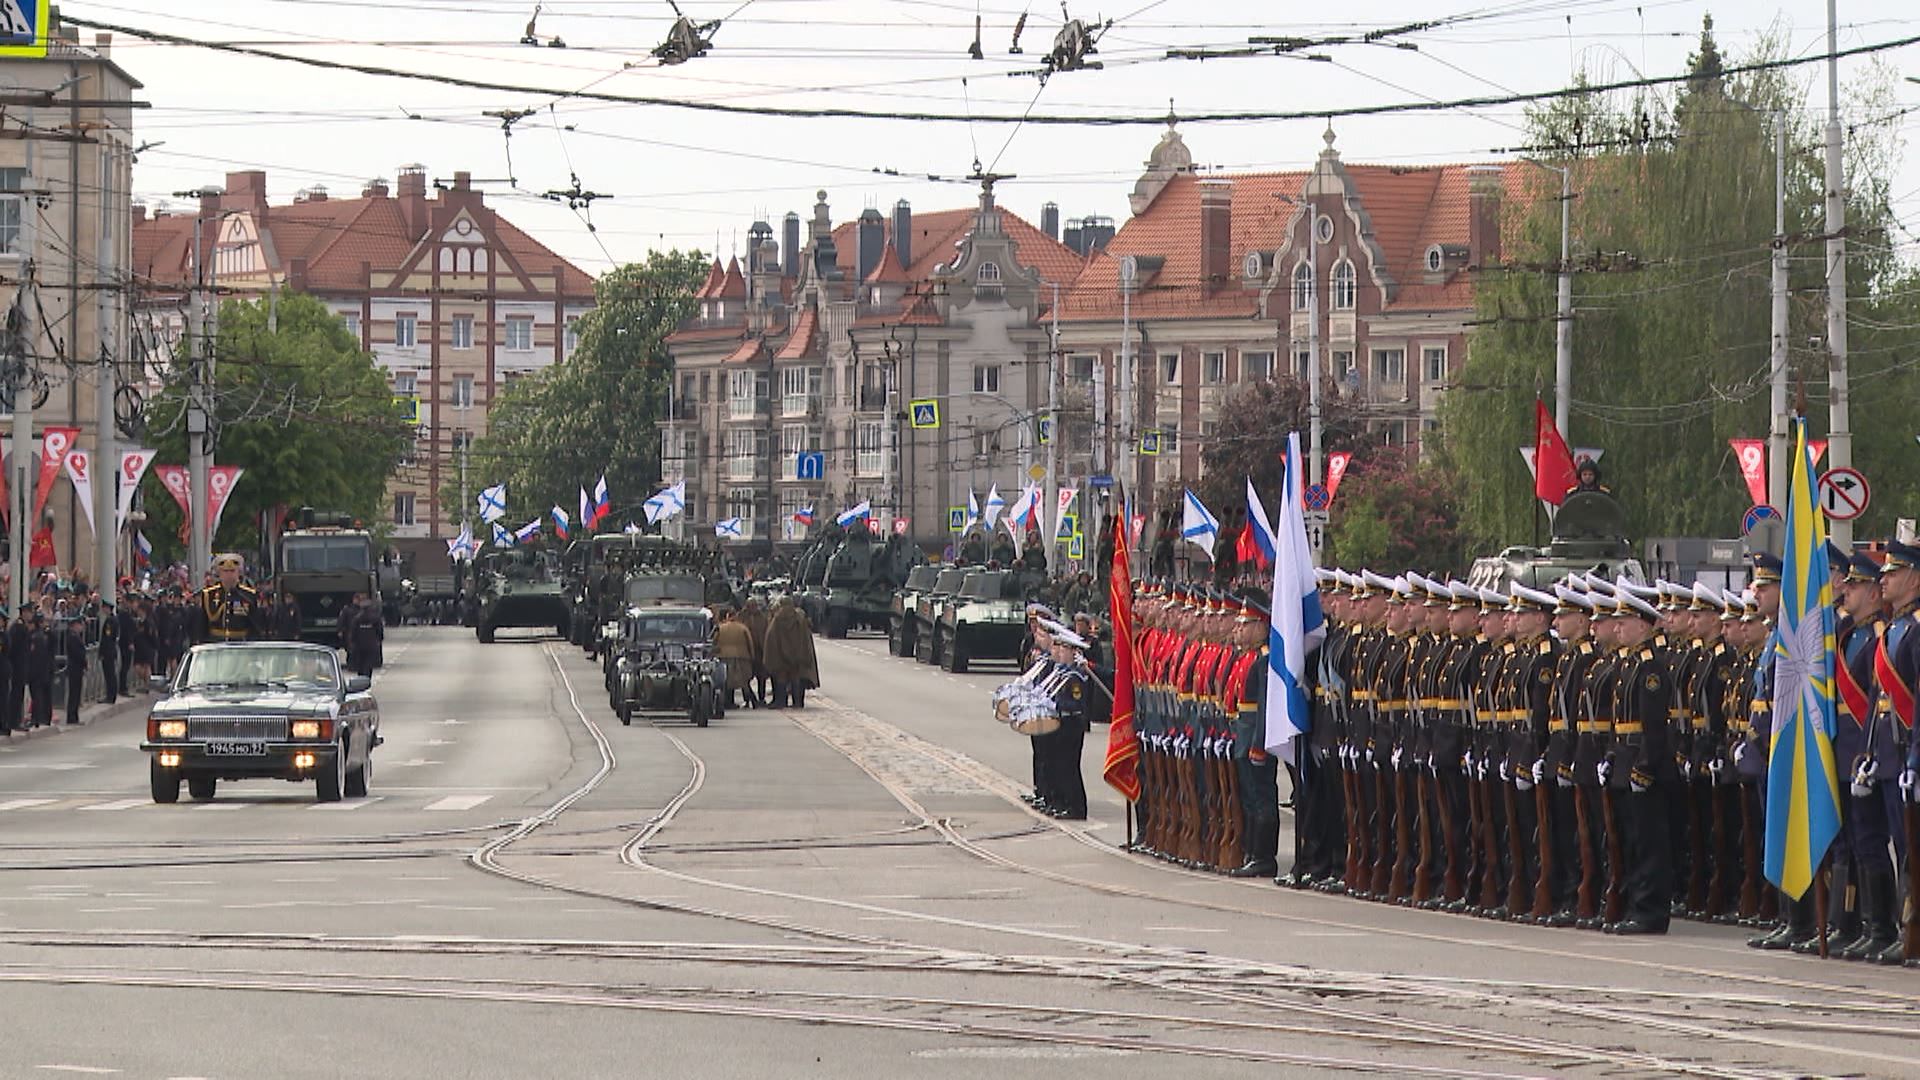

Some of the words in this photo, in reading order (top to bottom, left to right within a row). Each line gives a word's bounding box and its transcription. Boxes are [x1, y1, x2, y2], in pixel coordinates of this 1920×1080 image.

[1330, 455, 1345, 474] 9
[1743, 446, 1761, 473] 9
[210, 742, 234, 754] 1945
